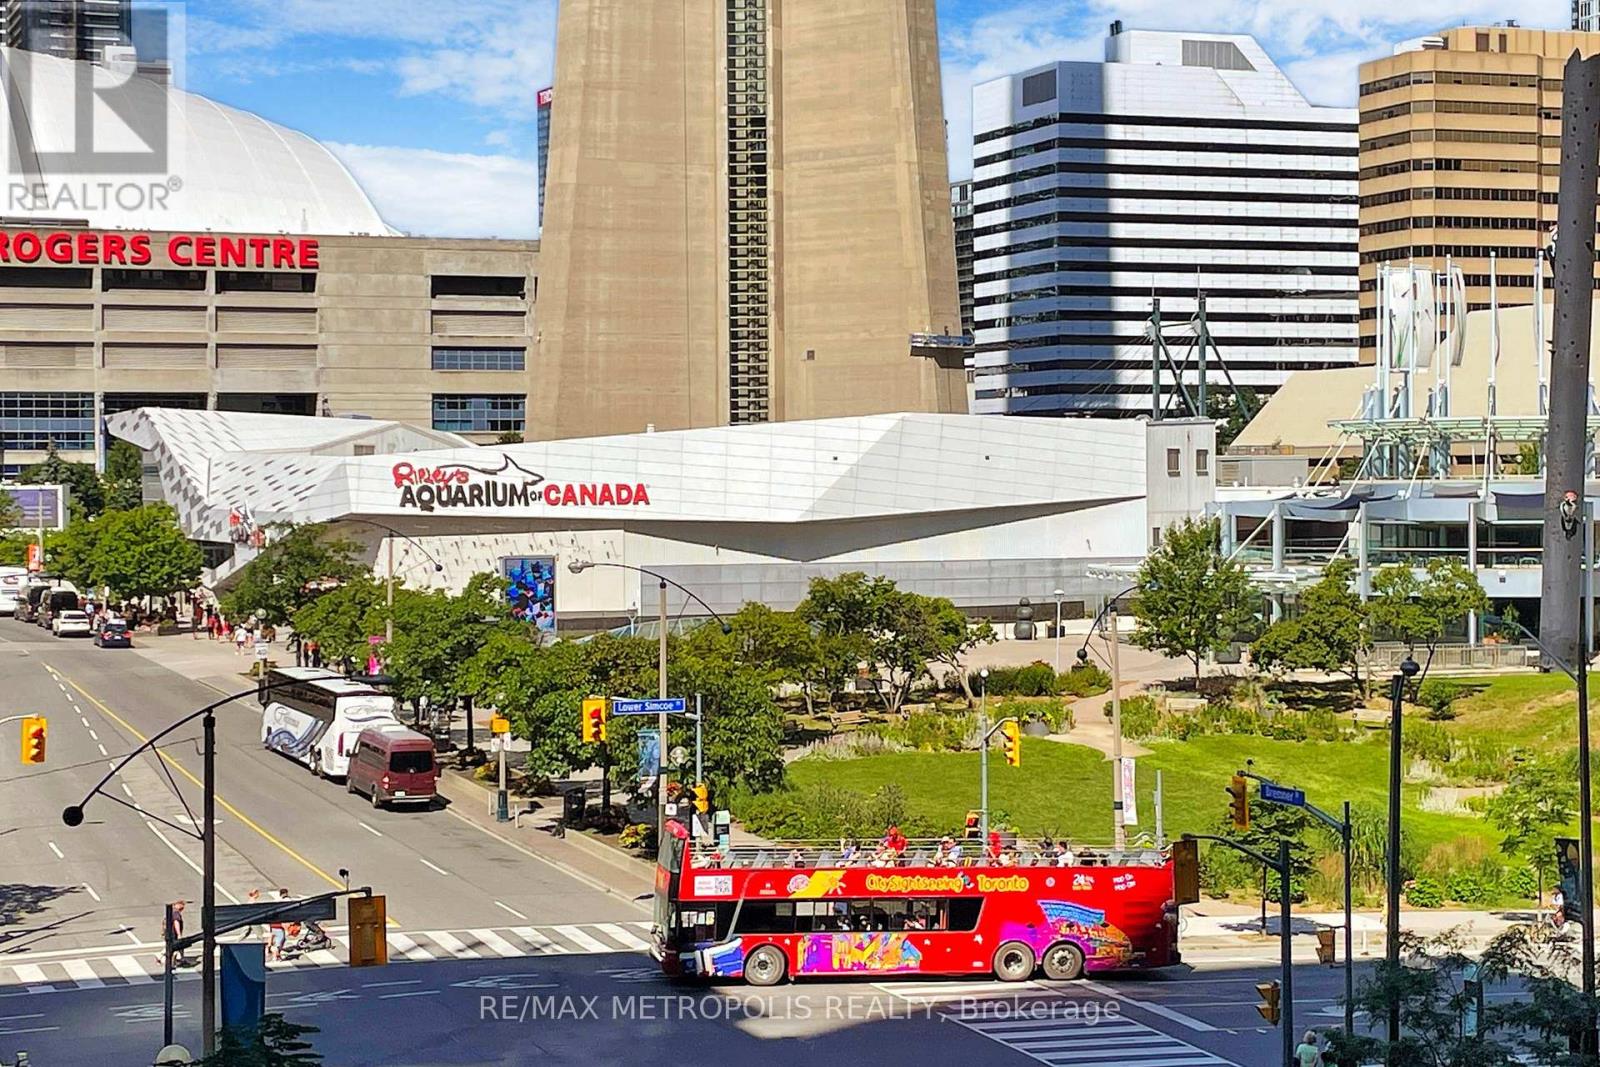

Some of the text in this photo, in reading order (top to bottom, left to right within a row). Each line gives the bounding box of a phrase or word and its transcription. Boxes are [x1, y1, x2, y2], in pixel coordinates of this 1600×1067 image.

[168, 235, 319, 269] CENTRE
[400, 480, 530, 512] AQUARIUM
[544, 483, 650, 506] CANADA
[617, 702, 643, 712] Lower
[644, 701, 674, 710] Simcoe
[976, 874, 1029, 892] Toronto
